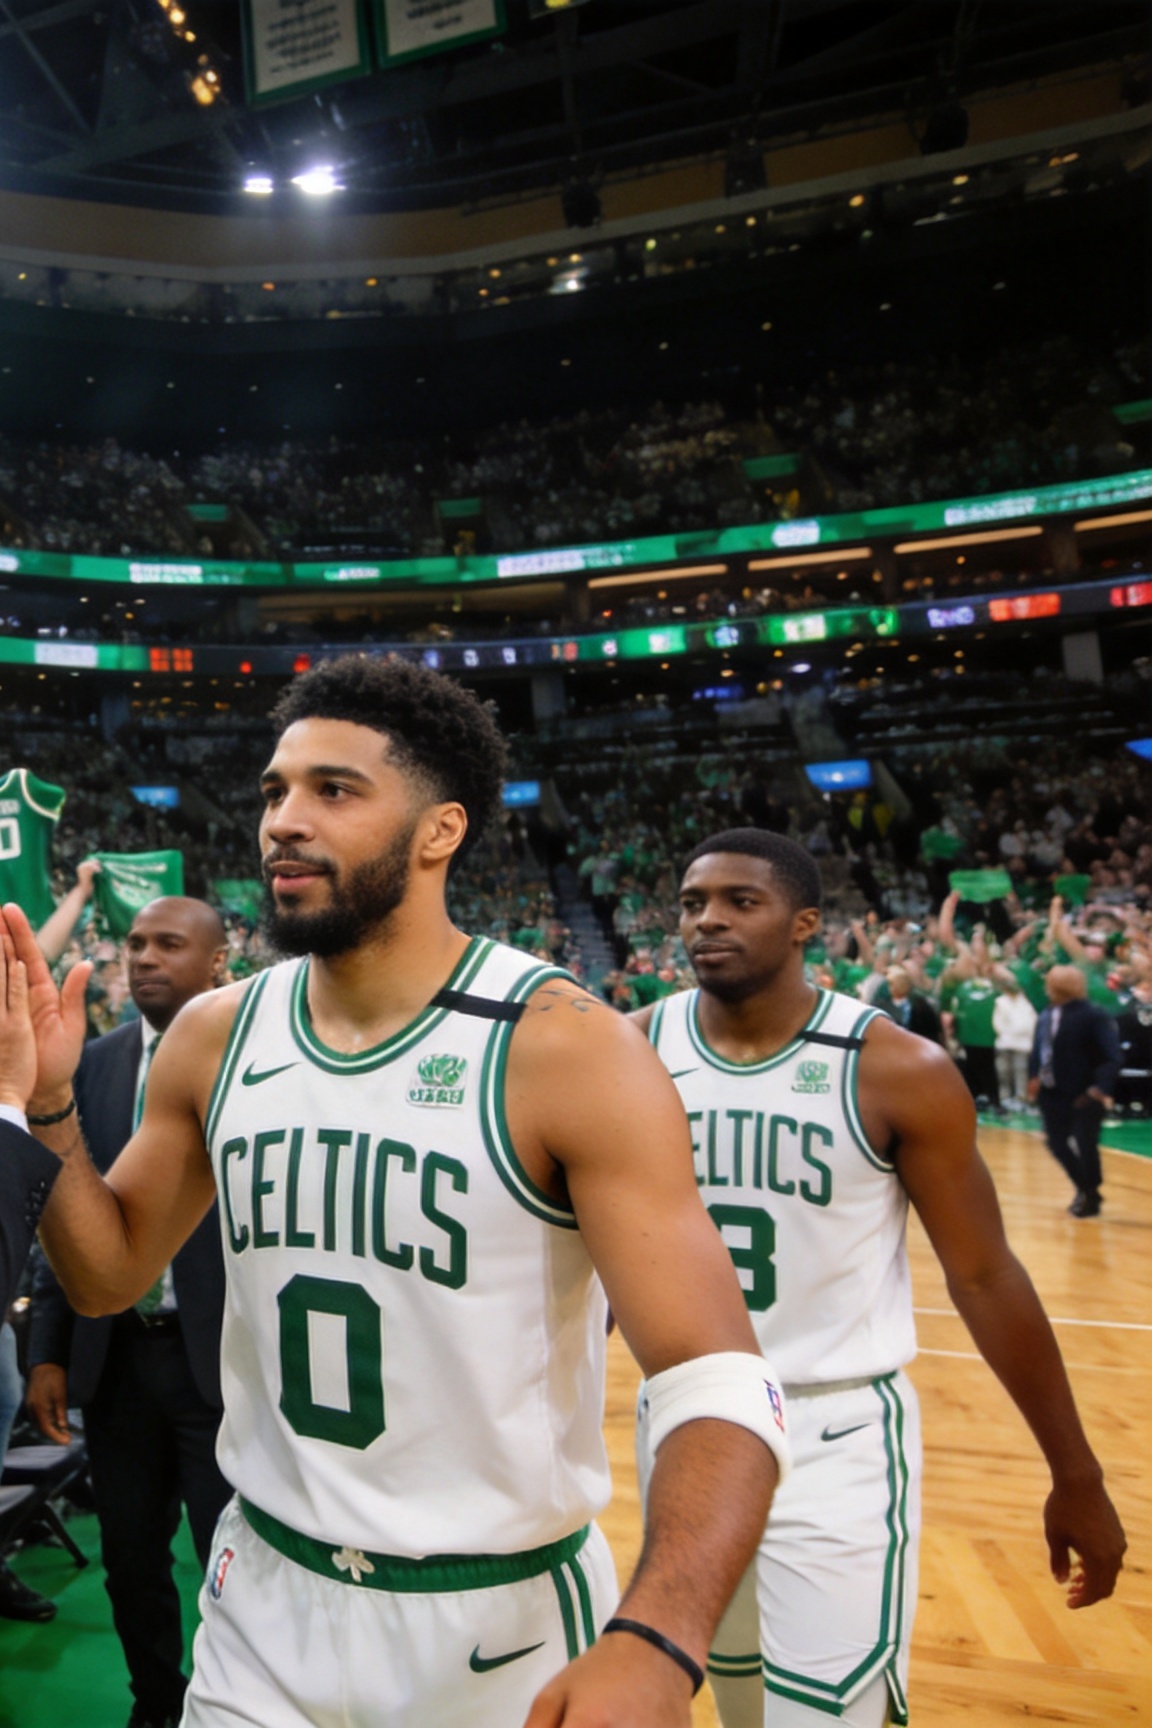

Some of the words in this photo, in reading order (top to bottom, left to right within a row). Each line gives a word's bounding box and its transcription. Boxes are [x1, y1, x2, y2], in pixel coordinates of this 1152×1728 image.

[221, 1127, 469, 1290] CELTICS
[686, 1109, 833, 1207] ELTICS
[276, 1273, 386, 1451] 0
